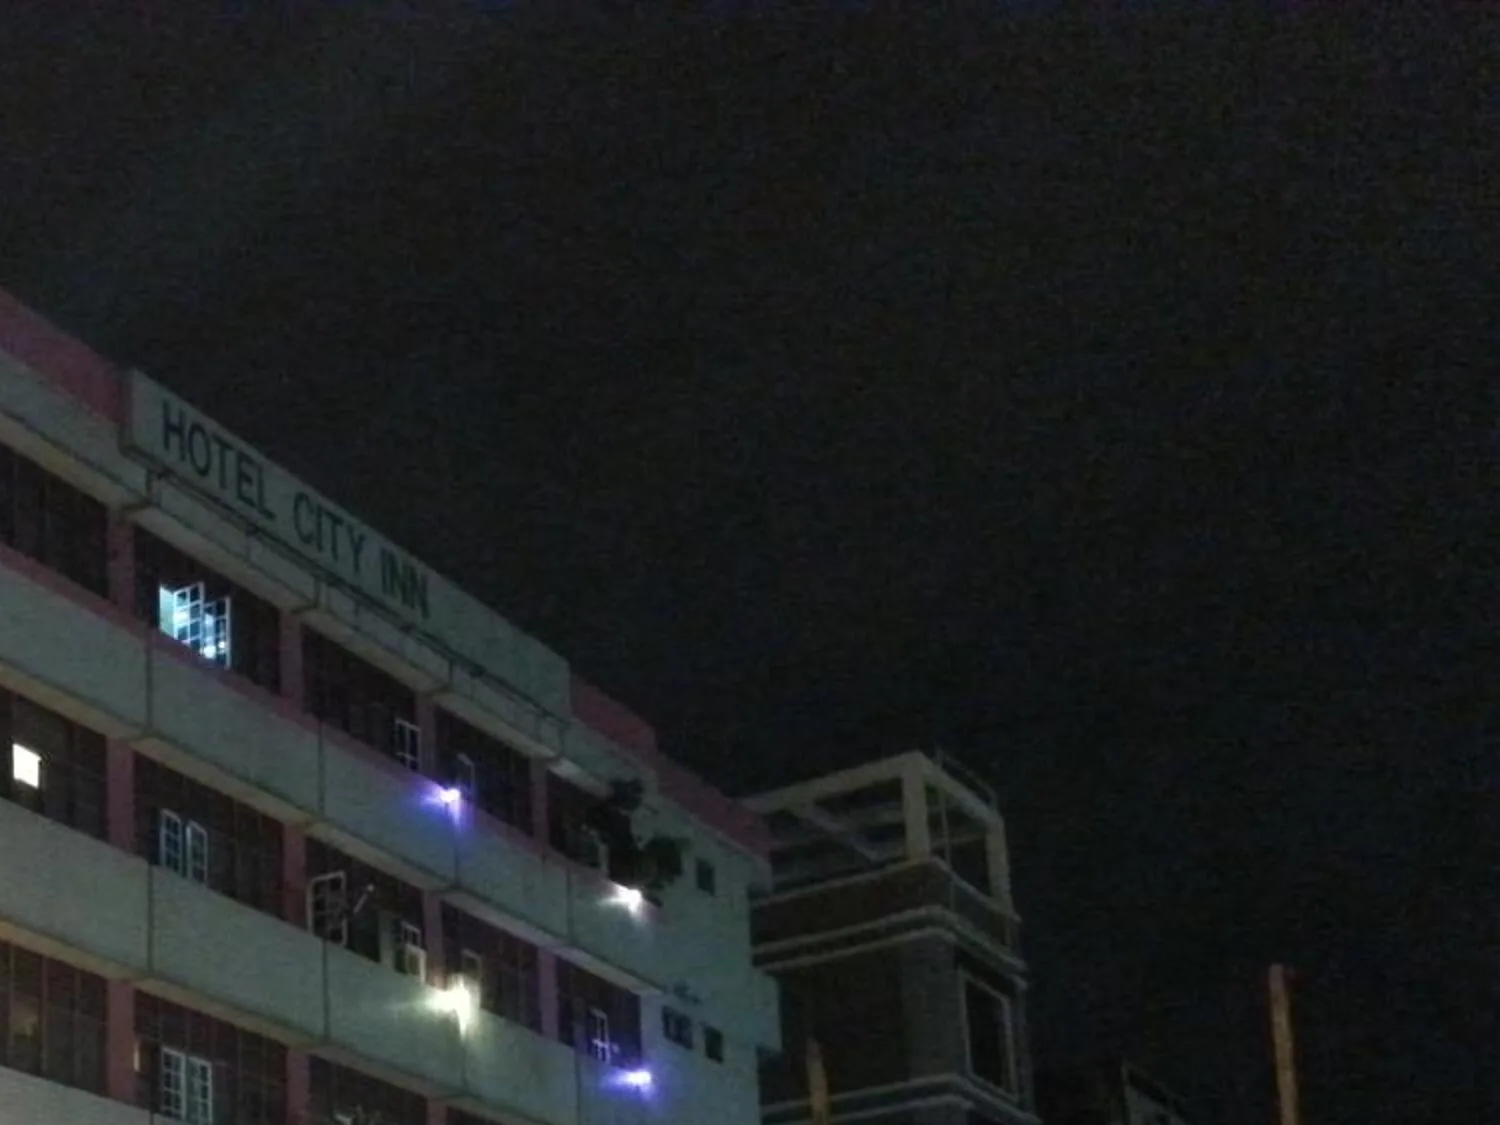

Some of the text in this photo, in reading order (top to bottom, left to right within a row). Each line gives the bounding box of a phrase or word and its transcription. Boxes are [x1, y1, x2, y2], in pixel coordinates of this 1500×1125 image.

[161, 400, 430, 620] HOTEL CITY INN
